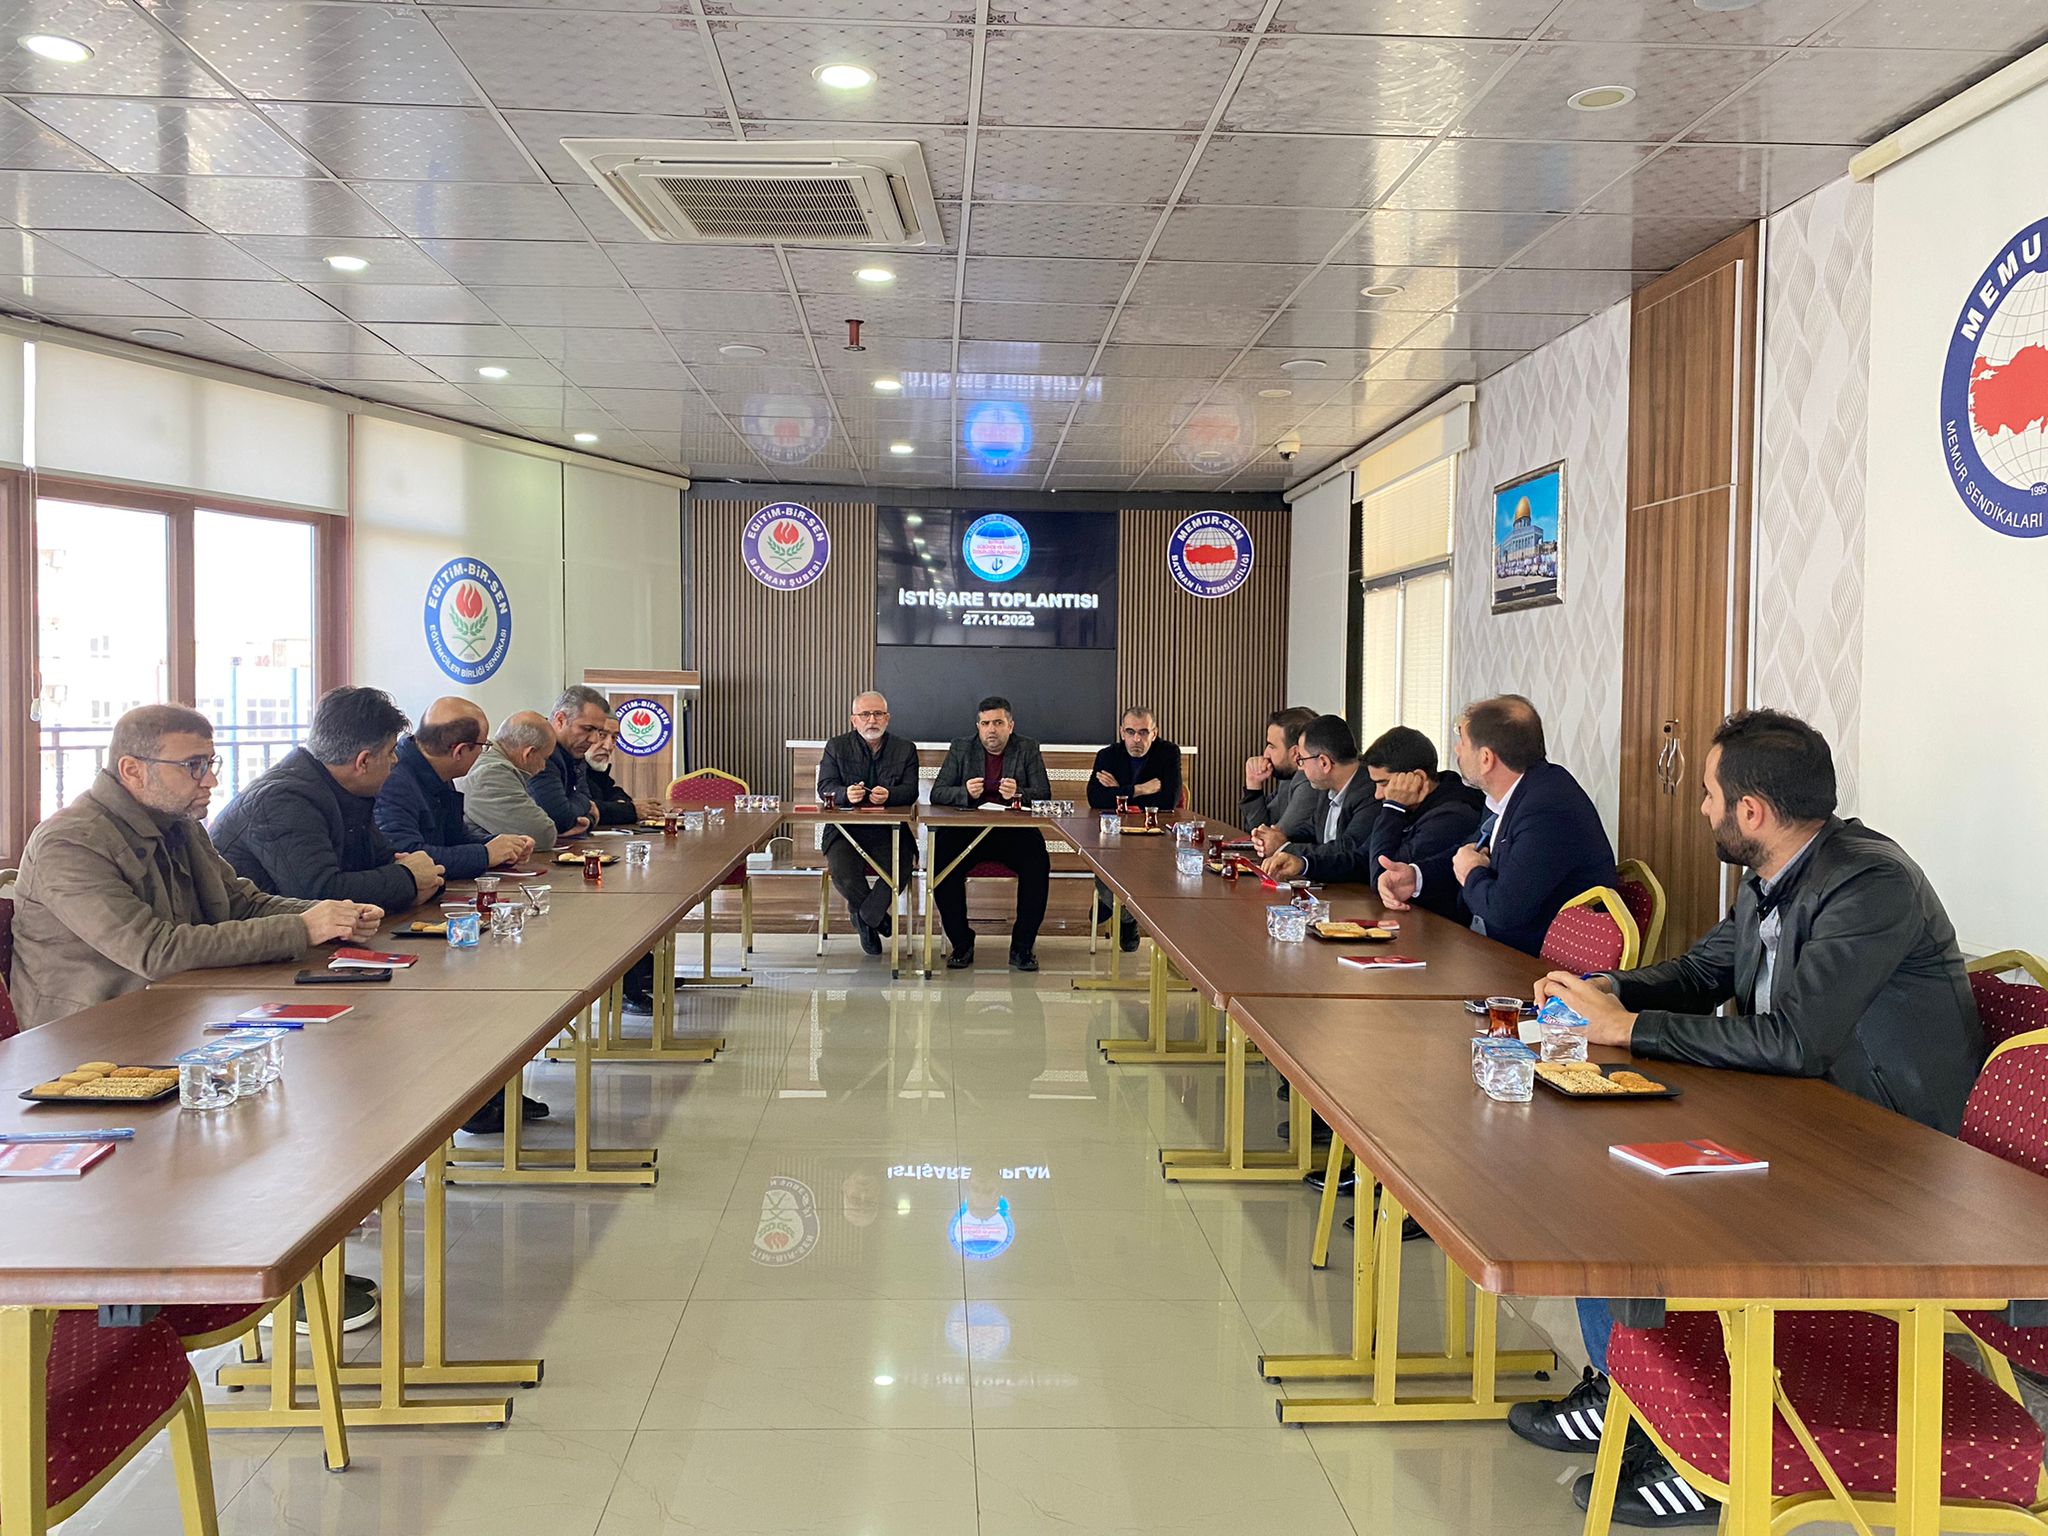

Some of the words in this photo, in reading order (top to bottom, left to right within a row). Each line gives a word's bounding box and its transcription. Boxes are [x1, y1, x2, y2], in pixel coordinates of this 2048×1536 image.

[1946, 419, 1968, 482] MEMUR
[1965, 481, 2042, 528] SENDİKALARI
[2030, 484, 2048, 496] 1995
[1177, 515, 1244, 542] MEMUR-SEN
[749, 558, 786, 586] BATMAN
[1171, 554, 1194, 588] BATMAN
[898, 588, 984, 609] İSTİŞARE
[988, 592, 1099, 608] TOPLANTISI
[962, 613, 1035, 626] 27.11.2022
[485, 629, 507, 671] SENDİKASI
[615, 700, 670, 725] ĞİTİM-BİR-SEN
